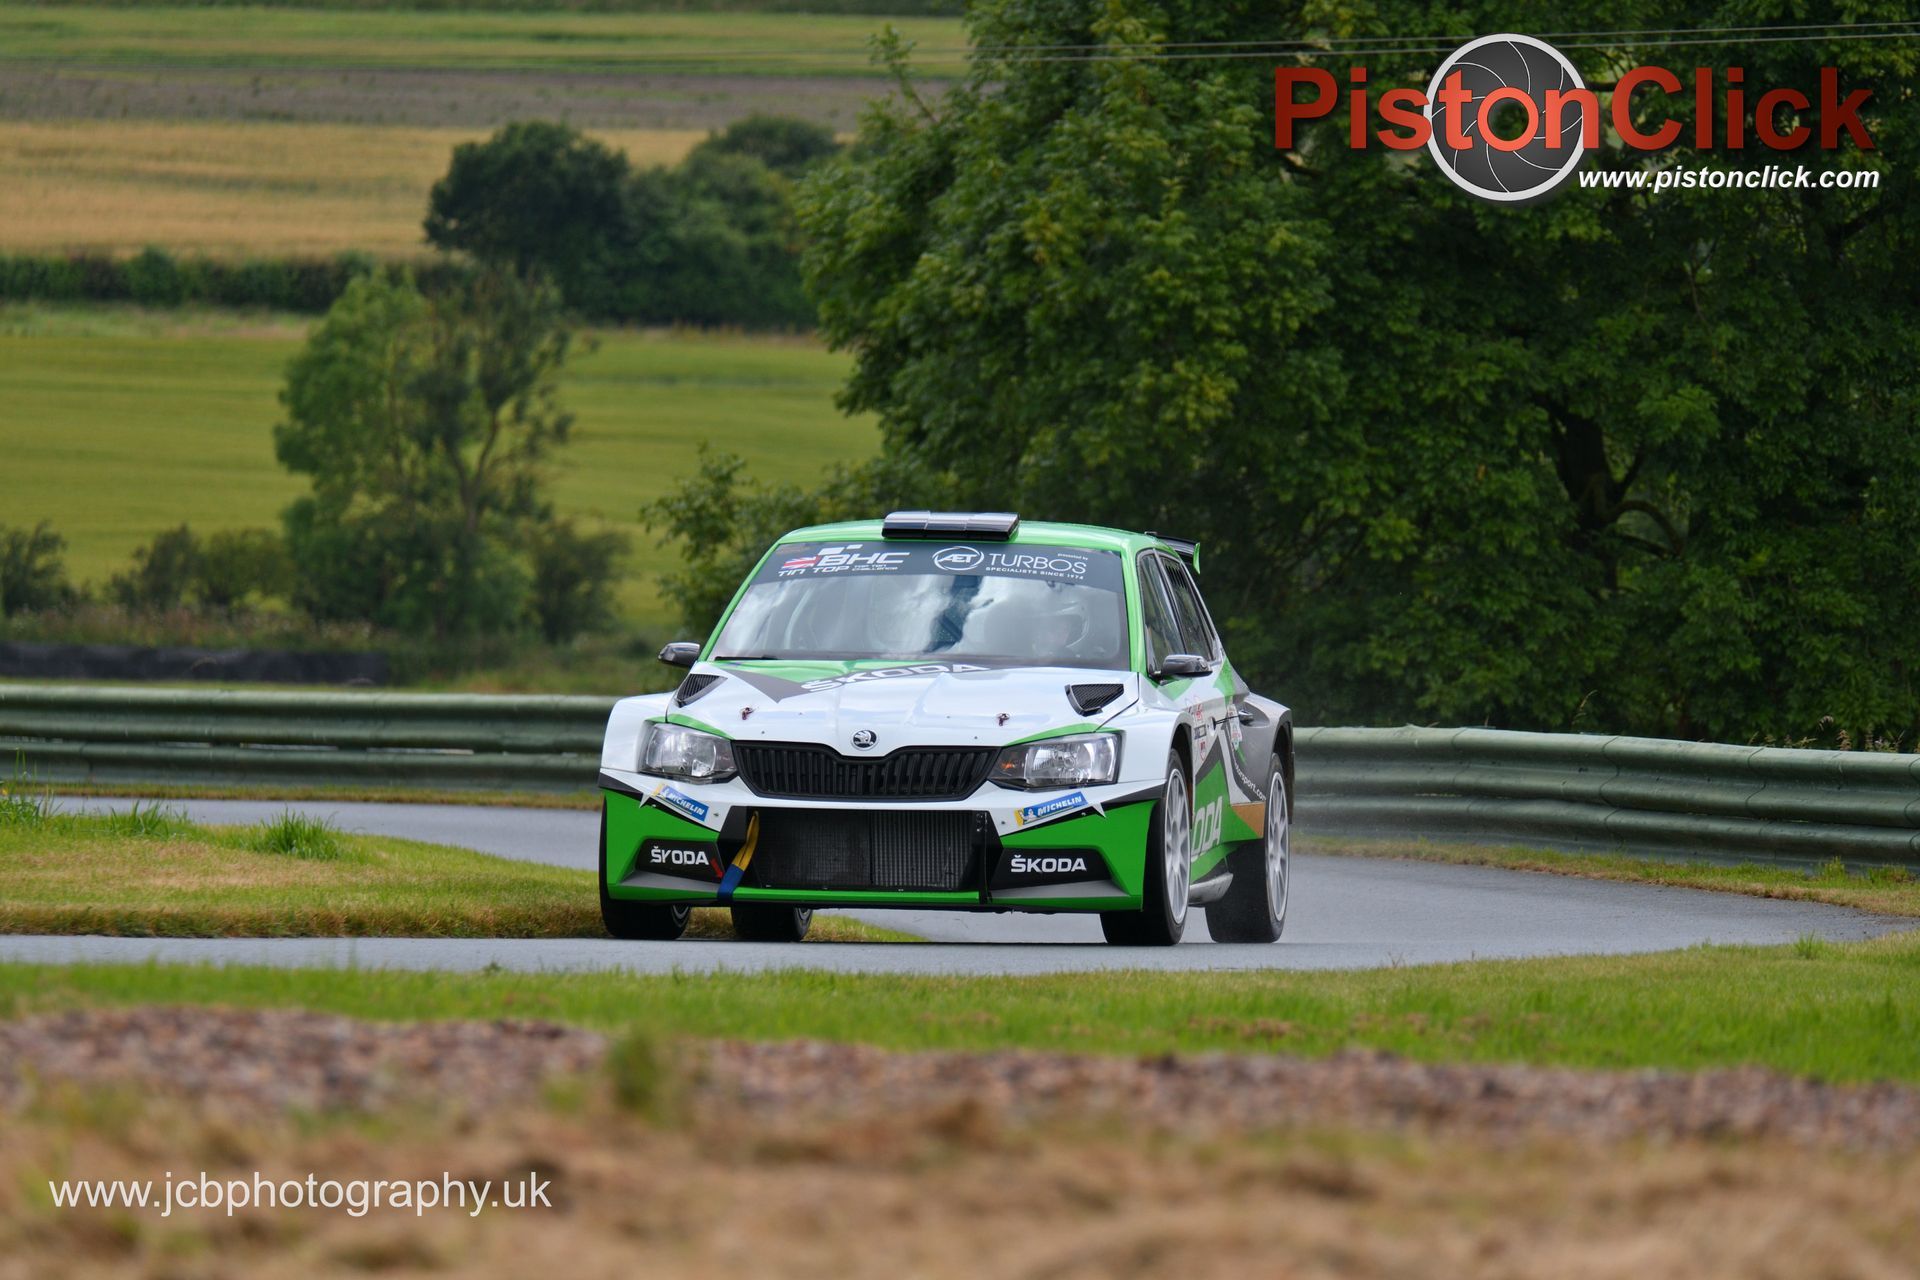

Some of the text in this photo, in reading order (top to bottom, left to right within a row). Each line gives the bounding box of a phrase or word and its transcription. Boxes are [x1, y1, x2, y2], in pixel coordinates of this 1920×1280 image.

[813, 565, 850, 574] TOP
[985, 566, 1038, 575] SPECIALISTS
[1040, 570, 1065, 578] SINCE
[989, 553, 1087, 575] TURBOS
[668, 790, 705, 816] MICHELIN
[1037, 795, 1083, 817] MICHELIN
[1010, 854, 1087, 874] ŠKODA
